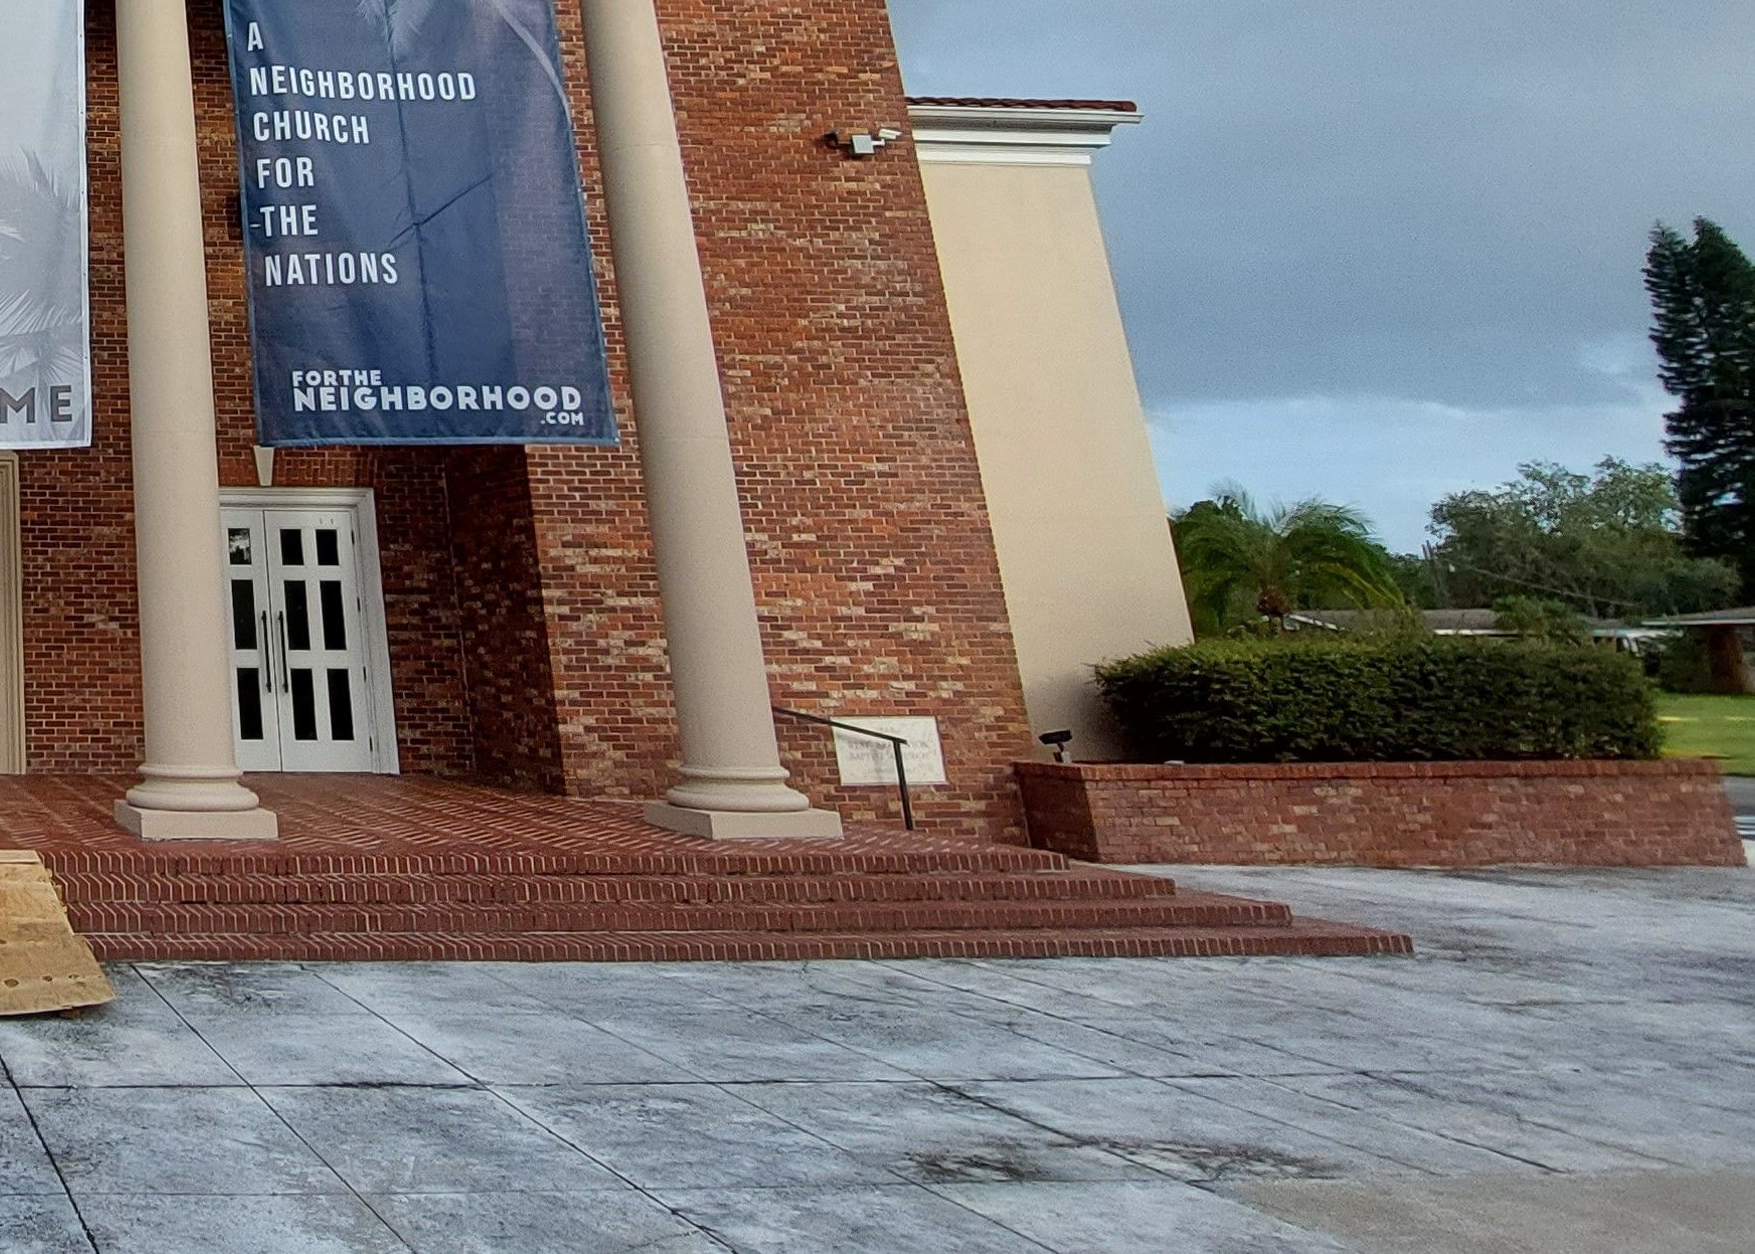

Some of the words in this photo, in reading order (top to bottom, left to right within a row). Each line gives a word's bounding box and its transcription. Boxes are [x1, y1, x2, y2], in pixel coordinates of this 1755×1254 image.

[247, 21, 264, 51] A
[250, 65, 476, 101] NEIGHBORHOOD
[253, 111, 369, 144] CHURCH
[257, 156, 314, 189] FOR
[259, 204, 318, 237] THE
[265, 252, 398, 286] NATIONS
[293, 386, 582, 412] NEIGHBORHOOD
[541, 411, 584, 427] .COM
